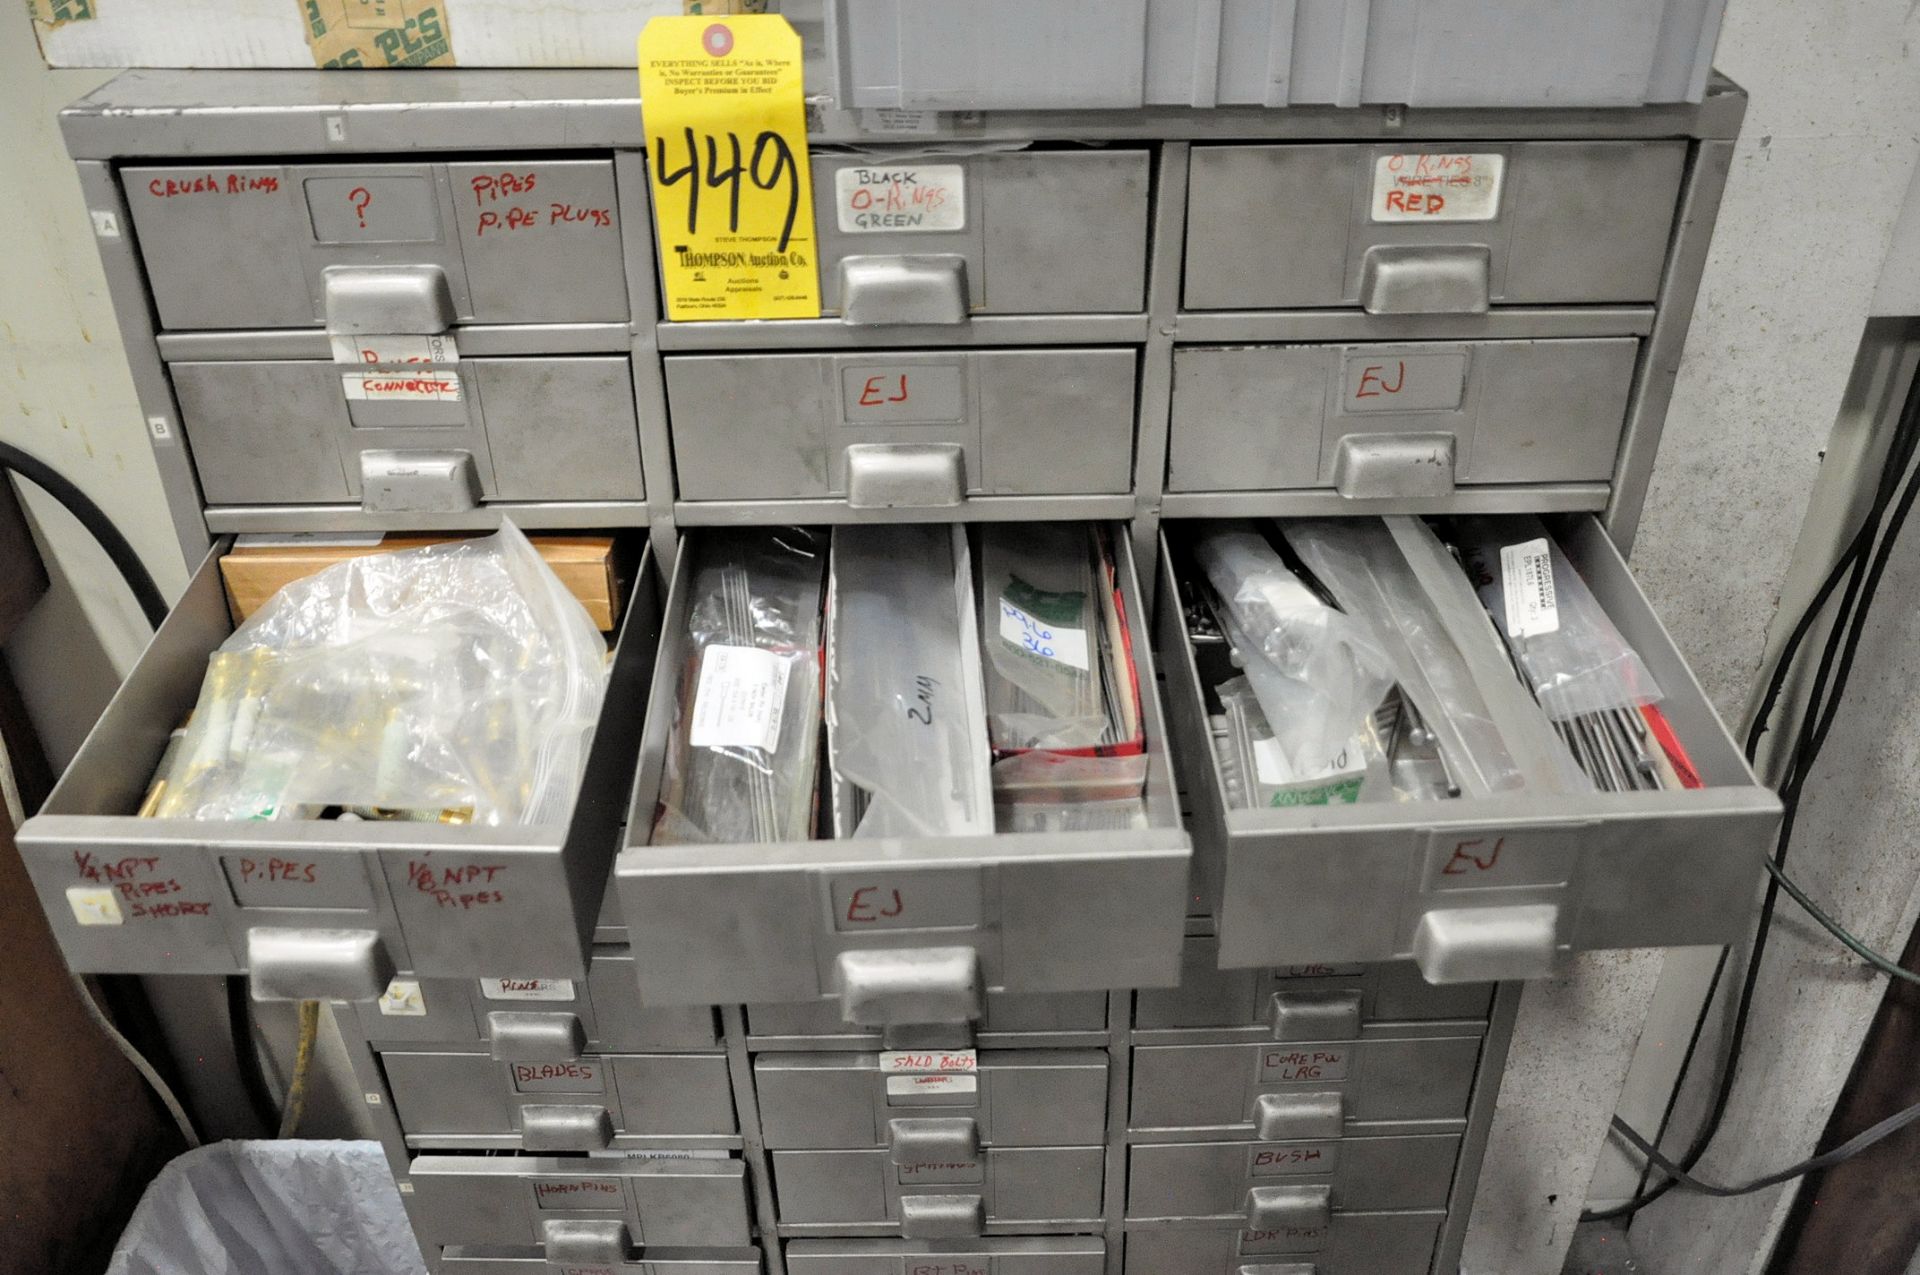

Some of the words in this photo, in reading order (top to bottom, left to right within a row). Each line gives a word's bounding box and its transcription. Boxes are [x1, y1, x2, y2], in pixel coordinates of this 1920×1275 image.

[650, 60, 708, 68] EVERYTHING
[674, 88, 702, 96] Buyer's
[705, 87, 738, 95] Premium
[750, 86, 772, 94] Effect
[855, 169, 918, 185] BLACK
[656, 127, 799, 253] 449
[1386, 191, 1445, 214] RED
[103, 219, 114, 231] A
[855, 213, 923, 227] GREEN
[725, 286, 762, 294] Appraisals
[1356, 361, 1404, 398] EJ
[859, 374, 907, 405] EJ
[154, 423, 165, 435] B
[1441, 837, 1505, 875] EJ
[104, 857, 159, 881] NPT
[443, 865, 508, 885] NPT
[131, 901, 212, 918] SHORT
[847, 887, 903, 922] EJ
[517, 1064, 593, 1082] BLADES
